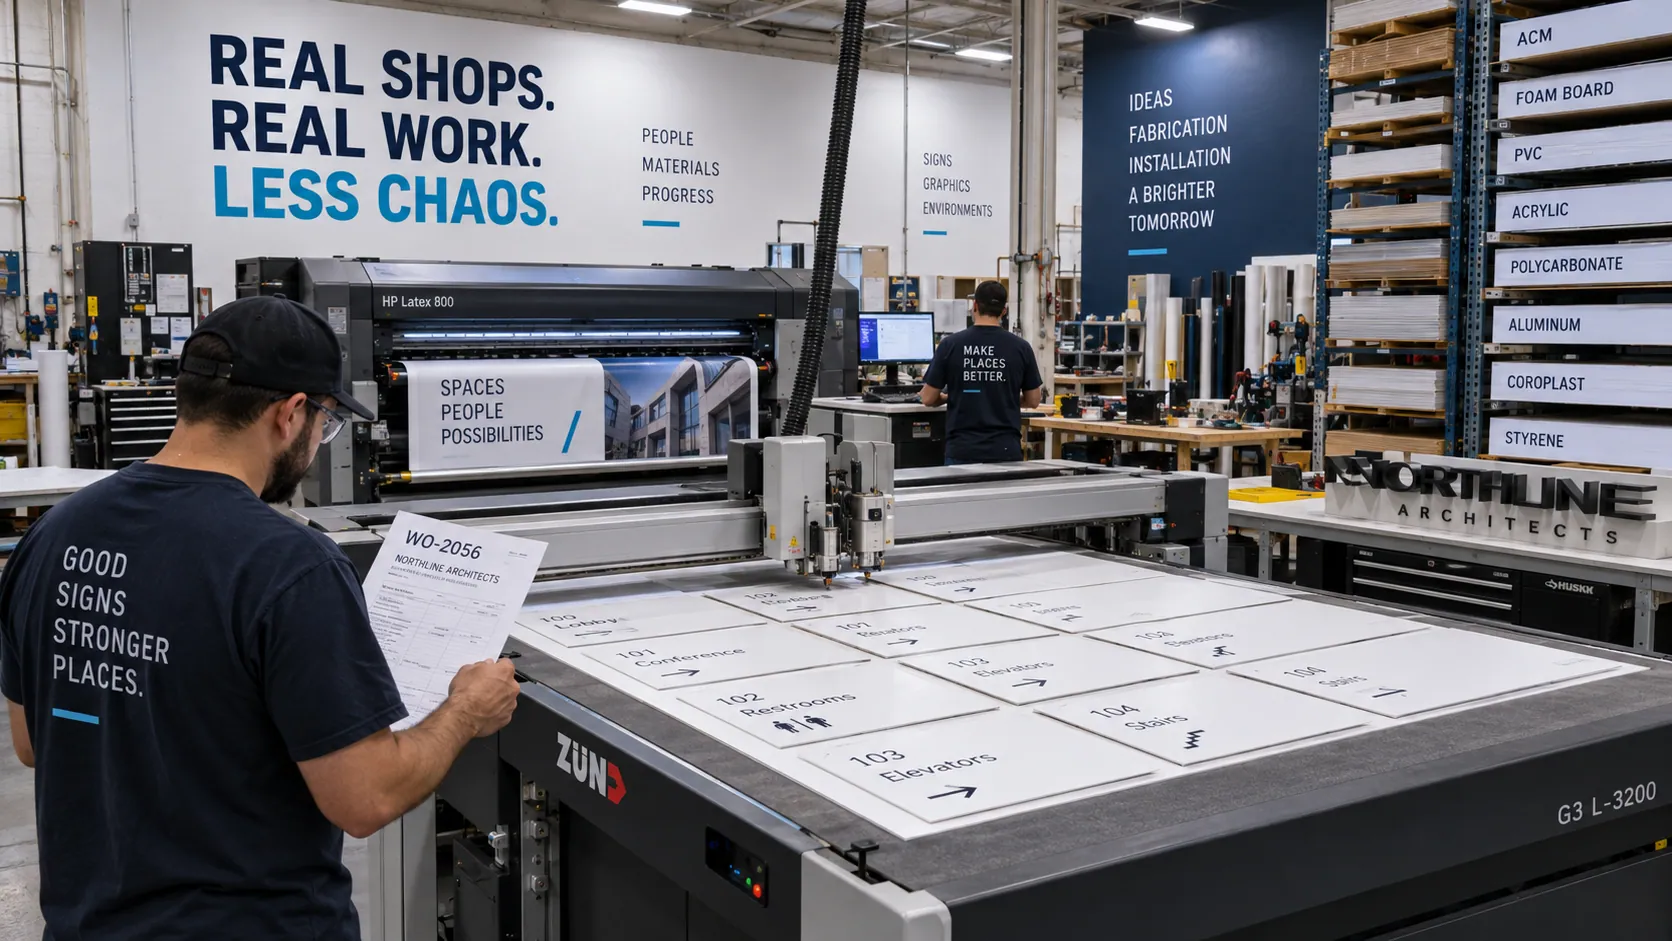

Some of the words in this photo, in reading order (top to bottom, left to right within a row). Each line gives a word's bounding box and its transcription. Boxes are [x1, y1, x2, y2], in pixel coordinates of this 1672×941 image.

[1517, 27, 1552, 47] ACM
[210, 34, 364, 95] REAL
[381, 49, 555, 112] SHOPS.
[1129, 88, 1173, 112] IDEAS
[1516, 88, 1557, 105] FOAM
[1563, 81, 1614, 100] BOARD
[213, 100, 365, 158] REAL
[381, 111, 541, 167] WORK.
[642, 128, 694, 147] PEOPLE
[1129, 114, 1227, 144] FABRICATION
[923, 152, 952, 168] SIGNS
[1129, 146, 1231, 174] INSTALLATION
[1514, 146, 1542, 162] PVC
[642, 157, 720, 177] MATERIALS
[923, 177, 970, 193] GRAPHICS
[1129, 187, 1138, 204] A
[1144, 180, 1215, 203] BRIGHTER
[214, 165, 359, 221] LESS
[378, 174, 558, 226] CHAOS.
[642, 186, 714, 204] PROGRESS
[923, 202, 993, 218] ENVIRONMENTS
[1512, 202, 1569, 219] ACRYLIC
[1129, 210, 1214, 232] TOMORROW
[1511, 256, 1623, 274] POLYCARBONATE
[382, 296, 398, 307] HP
[401, 296, 431, 308] Latex
[434, 296, 454, 307] 800
[1508, 318, 1581, 332] ALUMINUM
[963, 345, 995, 356] MAKE
[963, 358, 1006, 368] PLACES
[963, 371, 1006, 382] BETTER.
[1507, 375, 1585, 391] COROPLAST
[441, 378, 504, 396] SPACES
[442, 402, 503, 421] PEOPLE
[442, 425, 543, 445] POSSIBILITIES
[1505, 431, 1564, 448] STYRENE
[1398, 504, 1617, 544] ARCHITECTS
[405, 529, 483, 560] WO-2056
[63, 545, 128, 578] GOOD
[394, 554, 445, 573] NORTHLINE
[446, 565, 501, 584] ARCHITECTS
[56, 581, 127, 616] SIGNS
[53, 618, 170, 664] STRONGER
[616, 648, 656, 659] 101
[635, 649, 746, 668] Conference
[948, 657, 989, 668] 103
[53, 653, 143, 697] PLACES.
[716, 692, 765, 706] 102
[740, 692, 856, 717] Restrooms
[1090, 704, 1140, 719] 104
[1125, 713, 1188, 731] Stairs
[849, 749, 906, 767] 103
[879, 752, 998, 783] Elevators
[1558, 801, 1583, 825] G3
[1592, 781, 1657, 816] L-3200
